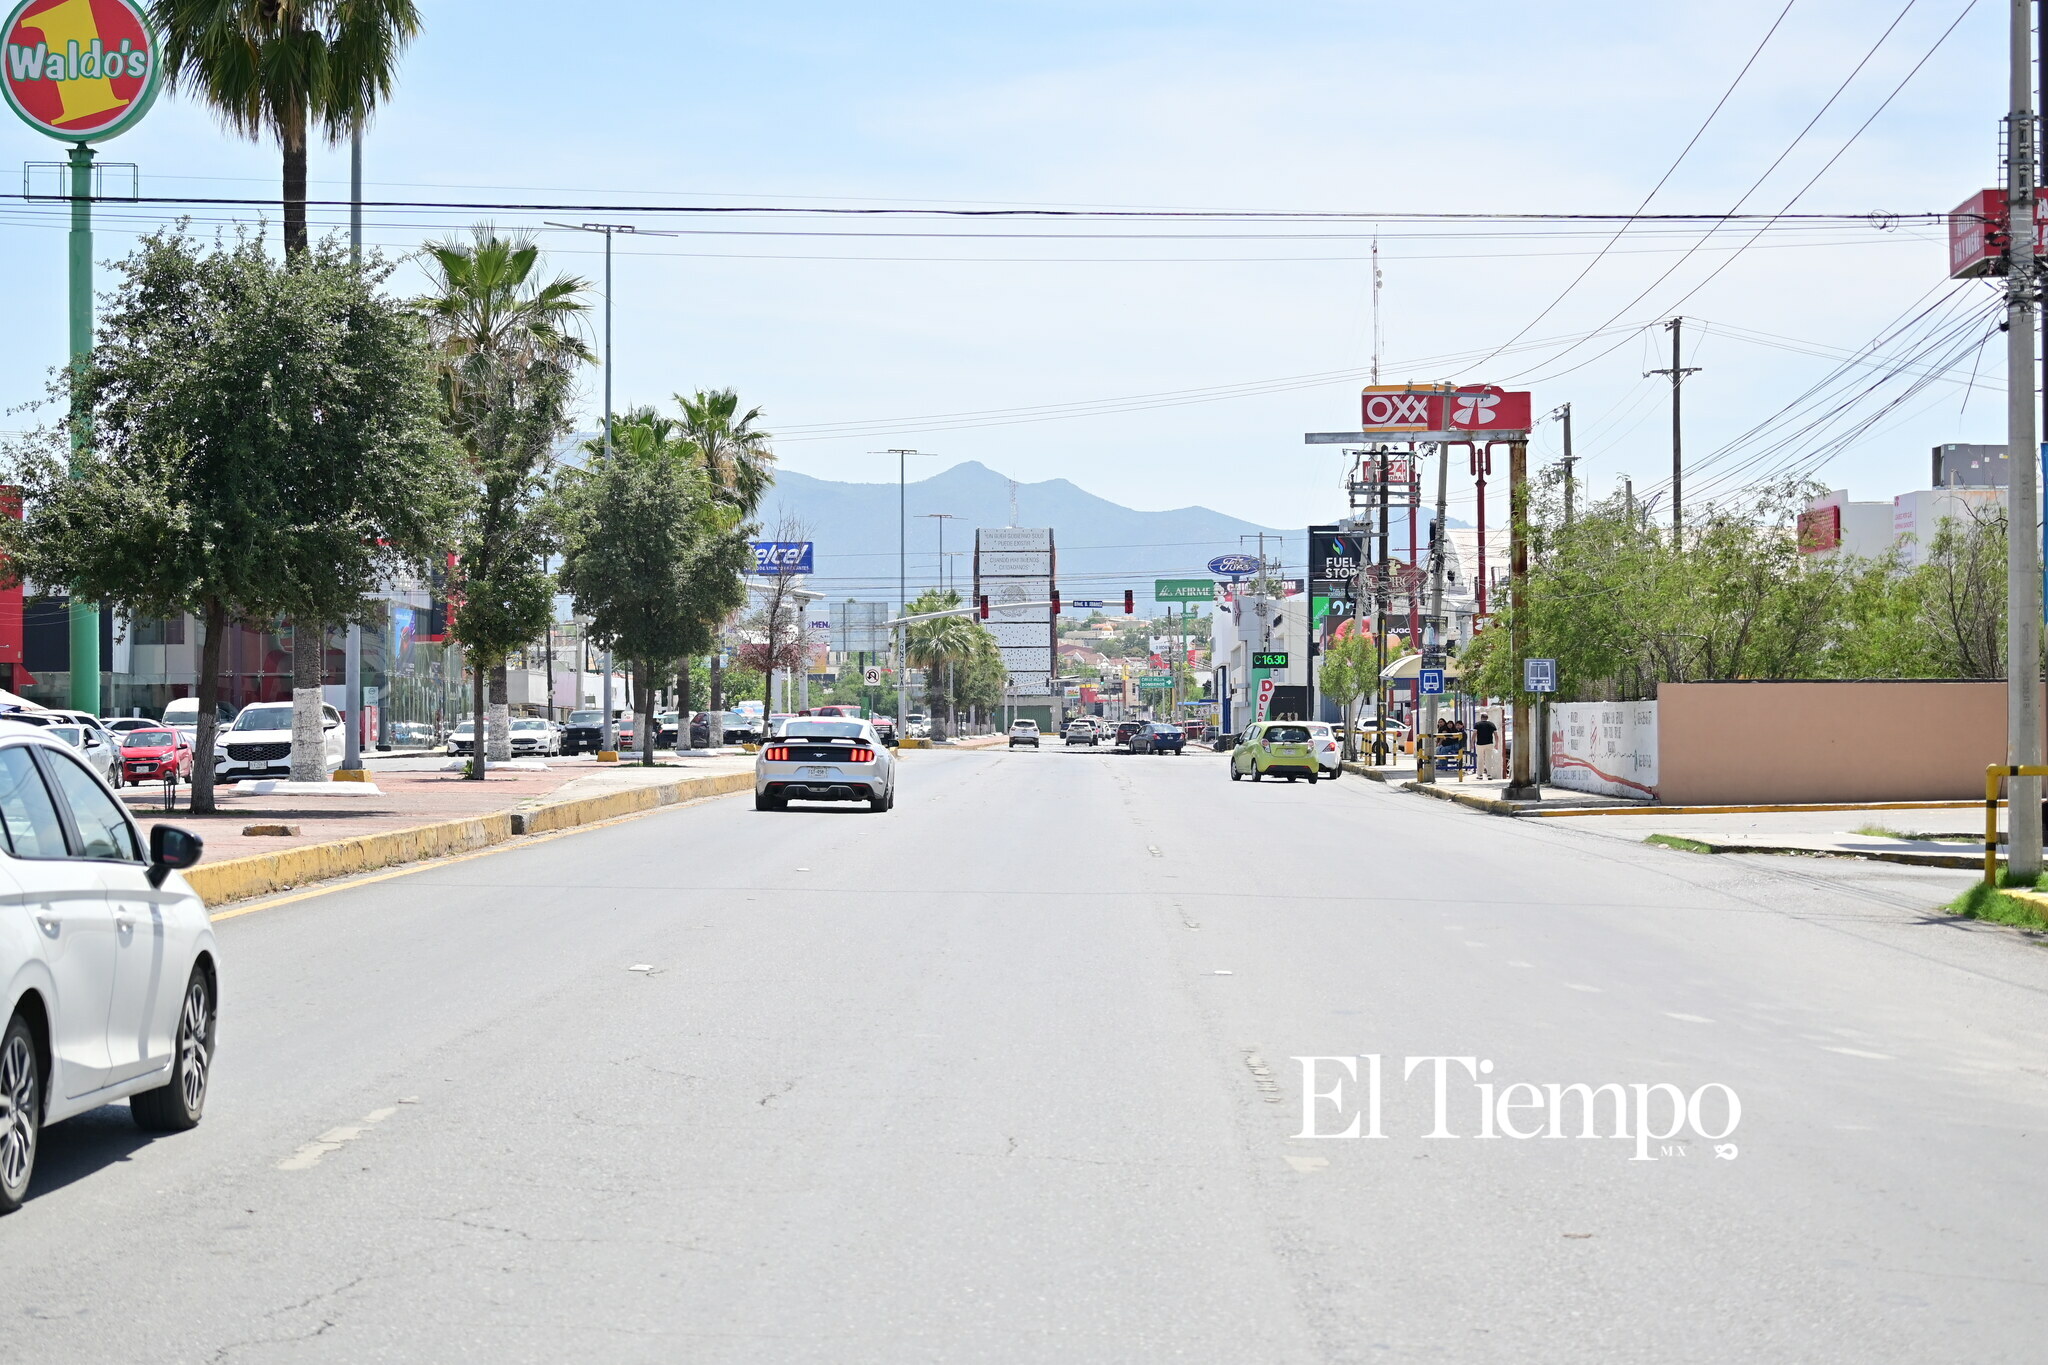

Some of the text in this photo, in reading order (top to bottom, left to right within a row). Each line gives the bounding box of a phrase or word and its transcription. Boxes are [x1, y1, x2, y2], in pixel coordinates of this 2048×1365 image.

[8, 38, 148, 81] Waldo's
[1366, 395, 1428, 425] OXX
[750, 544, 809, 565] elcel
[1220, 557, 1251, 572] Ford
[1326, 557, 1356, 568] FUEL
[1325, 568, 1358, 579] STOP
[1175, 587, 1211, 597] AFIRME
[1388, 627, 1423, 635] JUGOO
